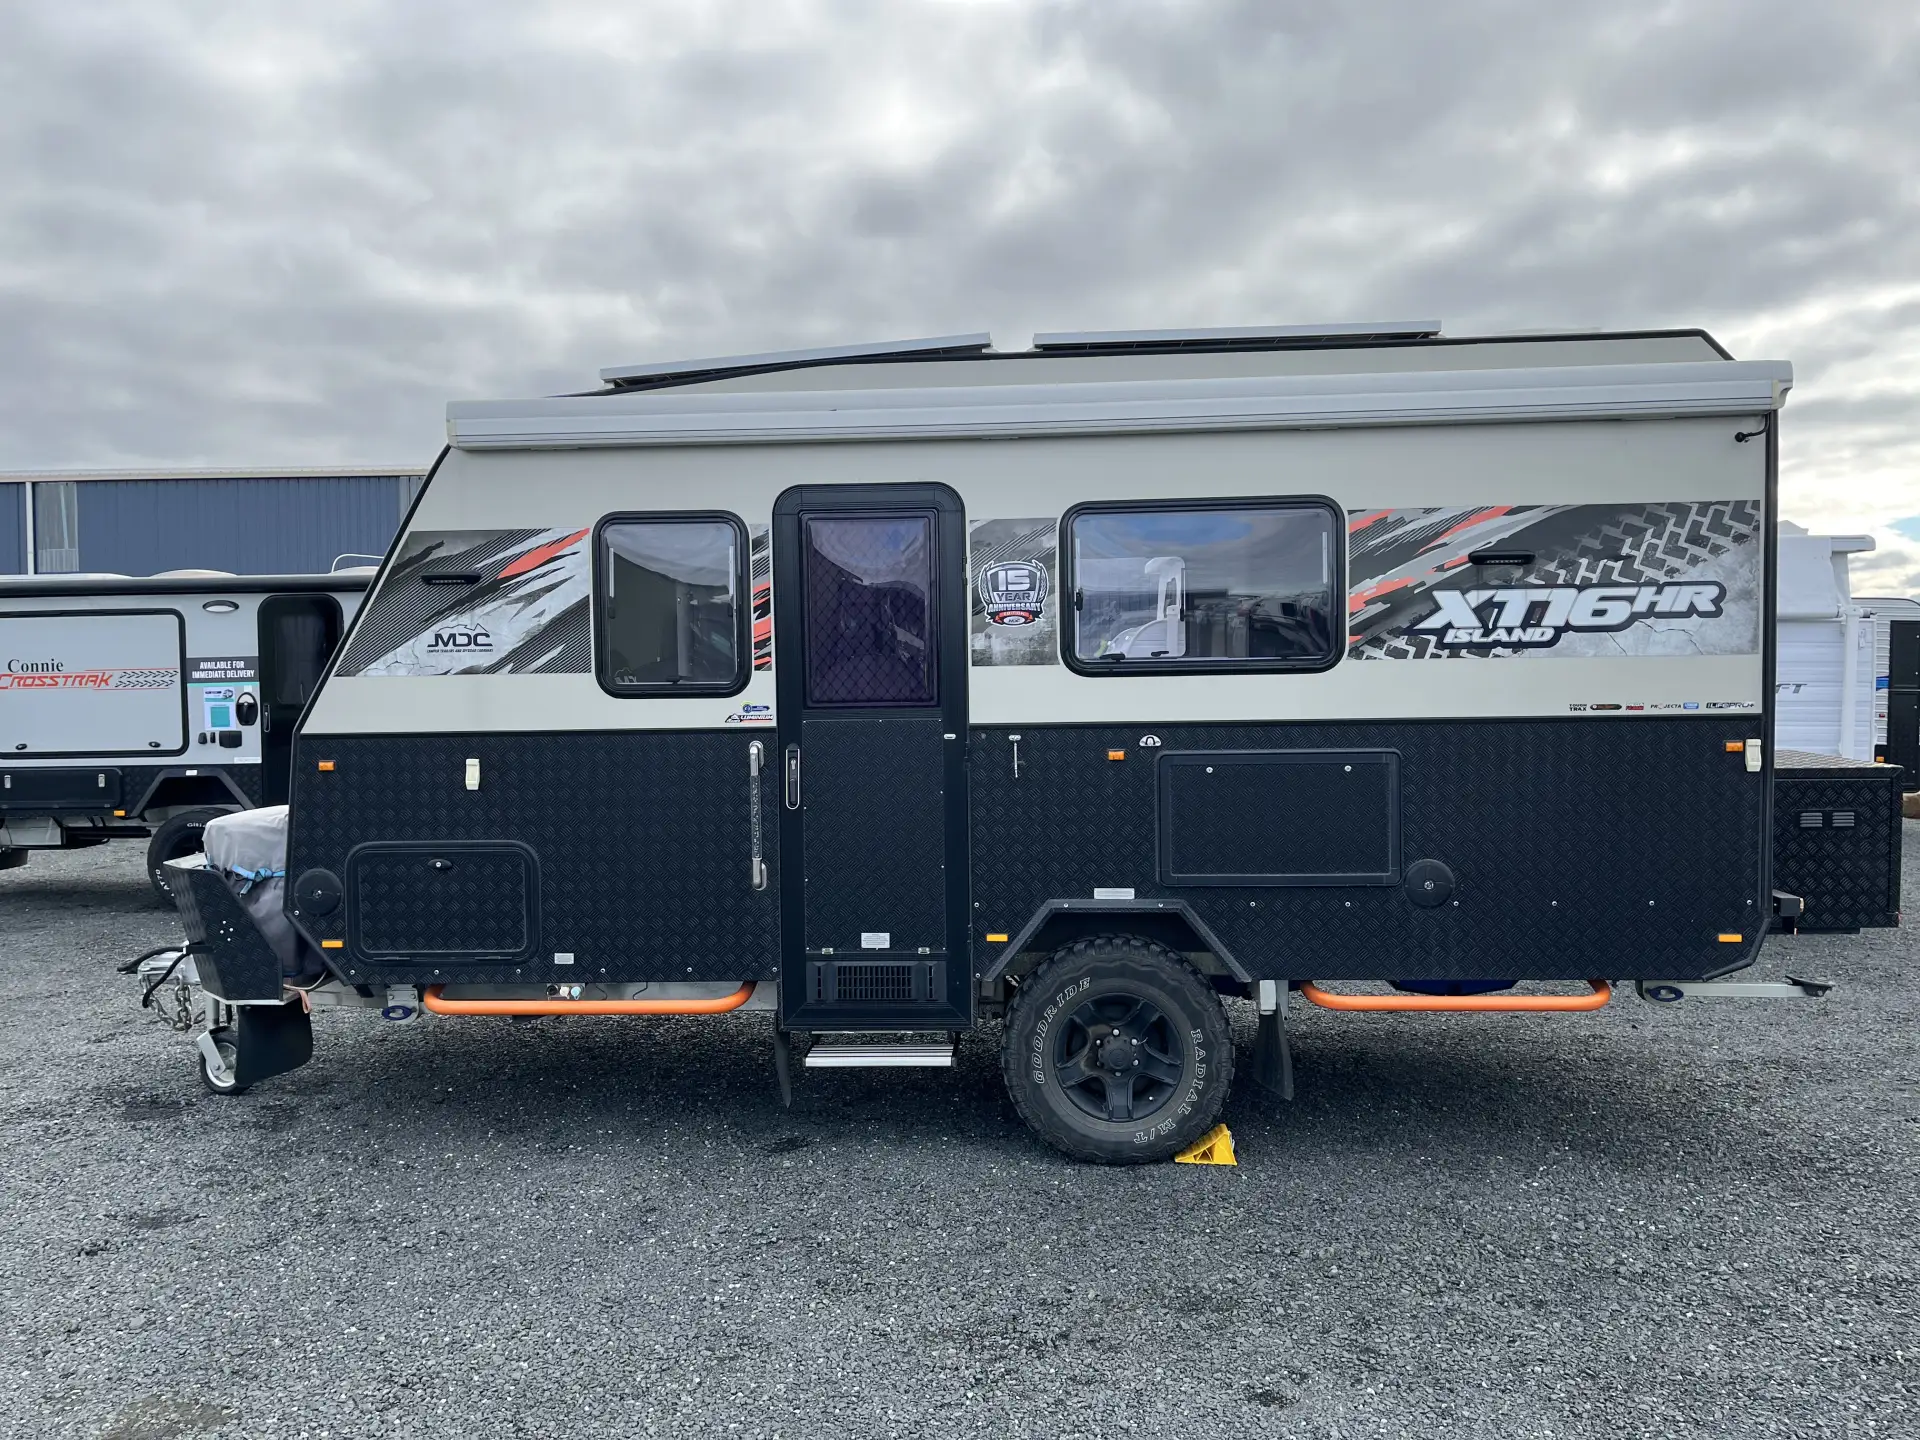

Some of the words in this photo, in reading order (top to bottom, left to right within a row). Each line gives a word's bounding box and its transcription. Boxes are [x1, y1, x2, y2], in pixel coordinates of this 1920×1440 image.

[998, 569, 1031, 591] 15
[996, 592, 1031, 602] YEAR
[988, 602, 1041, 613] ANNIVERSARY
[427, 633, 494, 648] MDC
[1443, 627, 1555, 644] ISLAND
[8, 658, 64, 674] Connie
[200, 661, 232, 670] AVAILABLE
[233, 660, 245, 669] FOR
[0, 672, 114, 690] CROSSTRAK
[192, 670, 226, 679] IMMEDIATE
[226, 669, 255, 678] DELIVERY
[1032, 976, 1091, 1084] GOODRIDE
[1178, 1028, 1207, 1116] RADIAL
[1133, 1118, 1177, 1144] M/T
